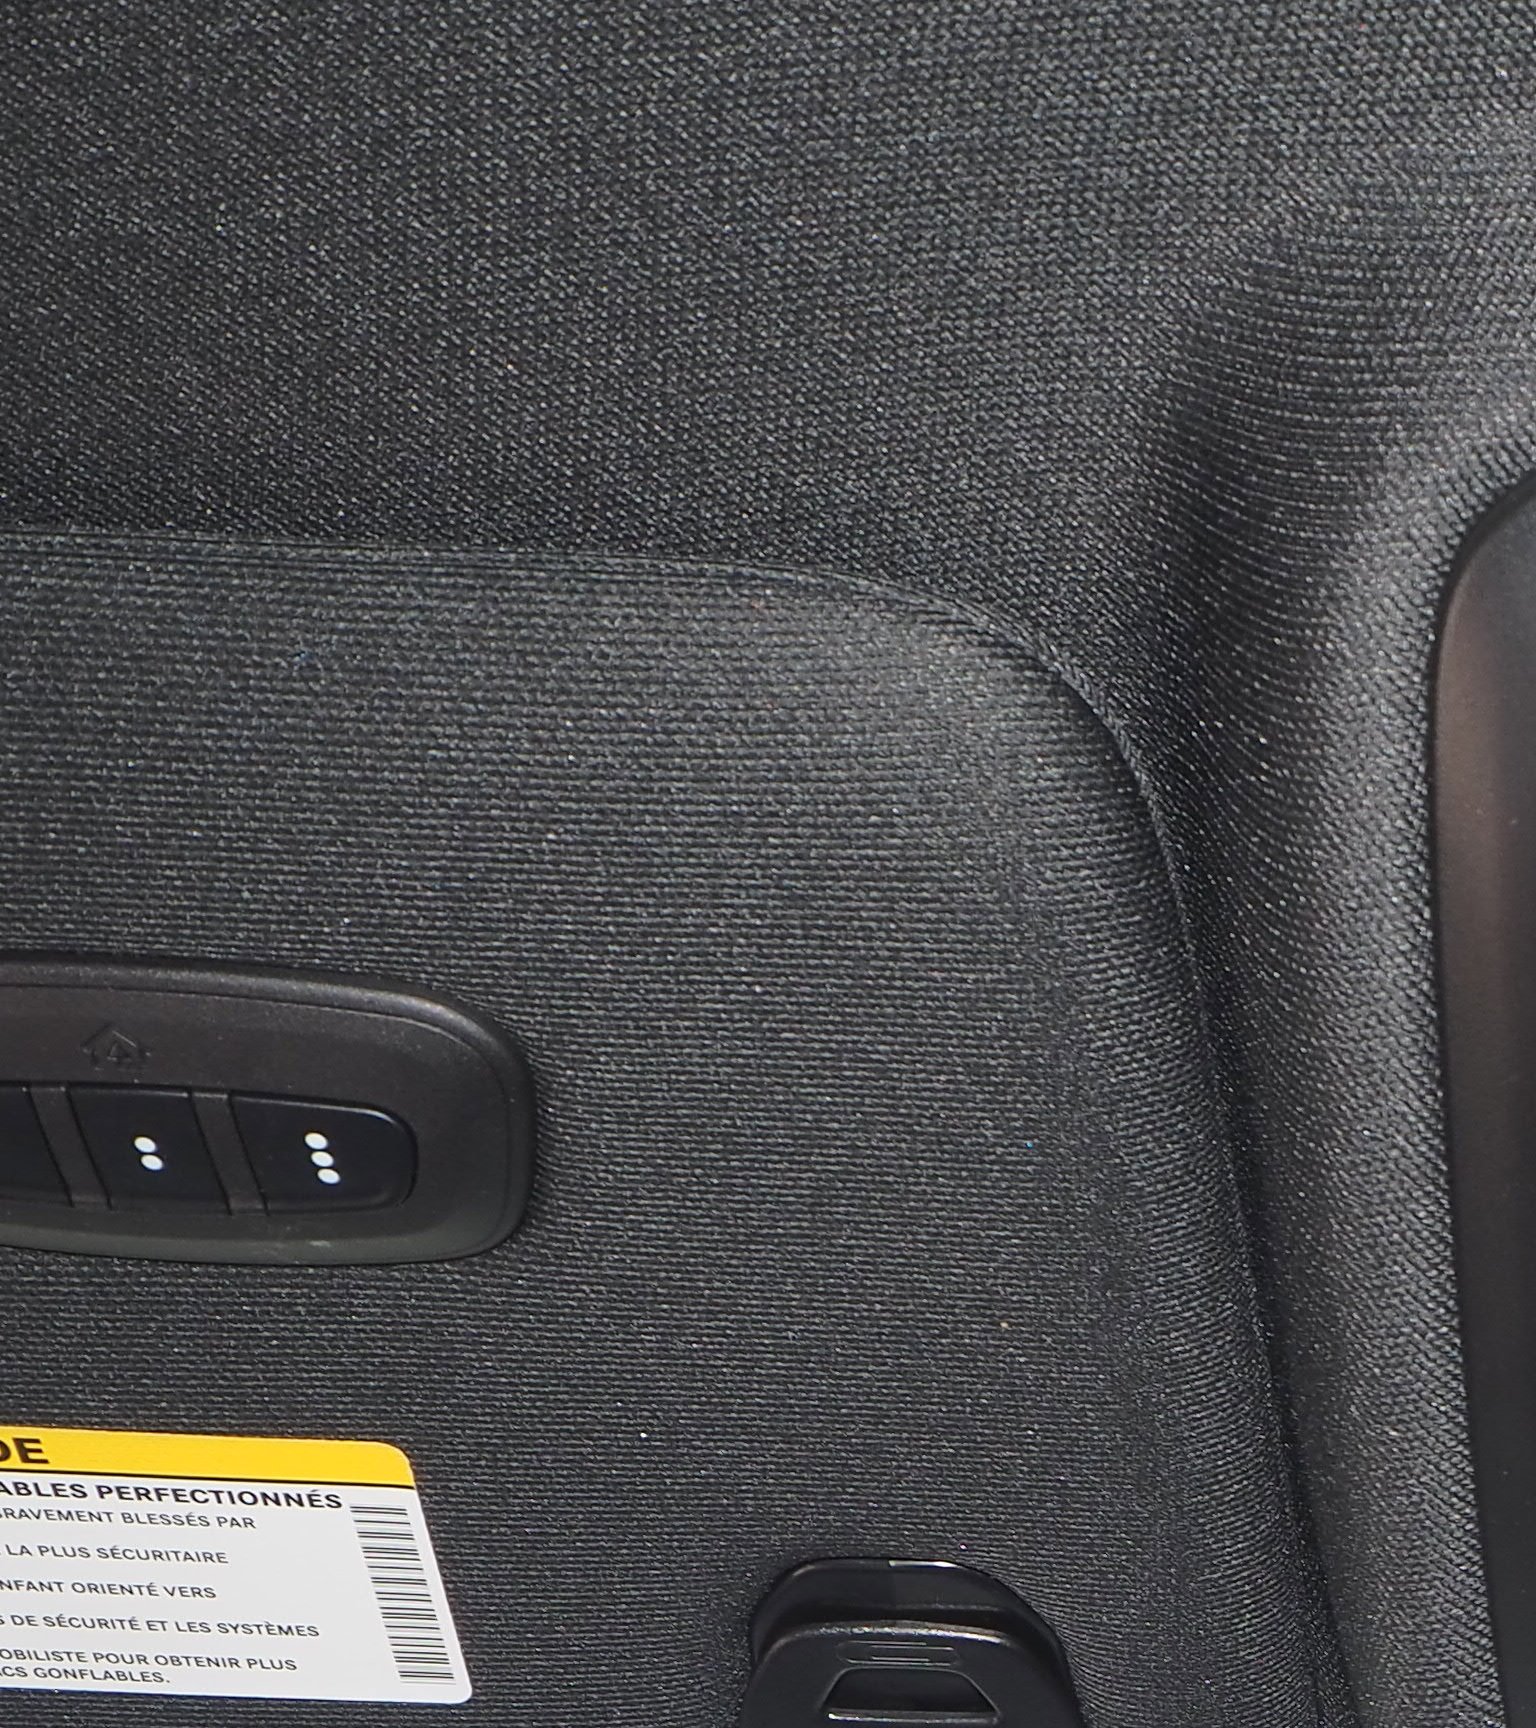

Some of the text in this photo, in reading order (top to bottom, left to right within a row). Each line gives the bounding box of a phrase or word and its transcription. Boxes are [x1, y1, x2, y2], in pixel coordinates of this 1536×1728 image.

[95, 1484, 344, 1509] PERFECTIONNÉS
[0, 1507, 257, 1529] RAVEMENT BLESSÉS PAR
[5, 1544, 229, 1564] LA PLUS SÉCURITAIRE
[71, 1582, 159, 1597] ORIENTÉ
[163, 1586, 217, 1600] VERS
[10, 1614, 40, 1627] DE
[42, 1613, 141, 1632] SÉCURITÉ
[146, 1619, 168, 1632] ET
[174, 1620, 212, 1634] LES
[216, 1620, 320, 1638] SYSTÈMES
[92, 1651, 149, 1666] POUR
[154, 1654, 242, 1670] OBTENIR
[246, 1657, 298, 1671] PLUS
[0, 1666, 171, 1684] CS GONFLABLES.
